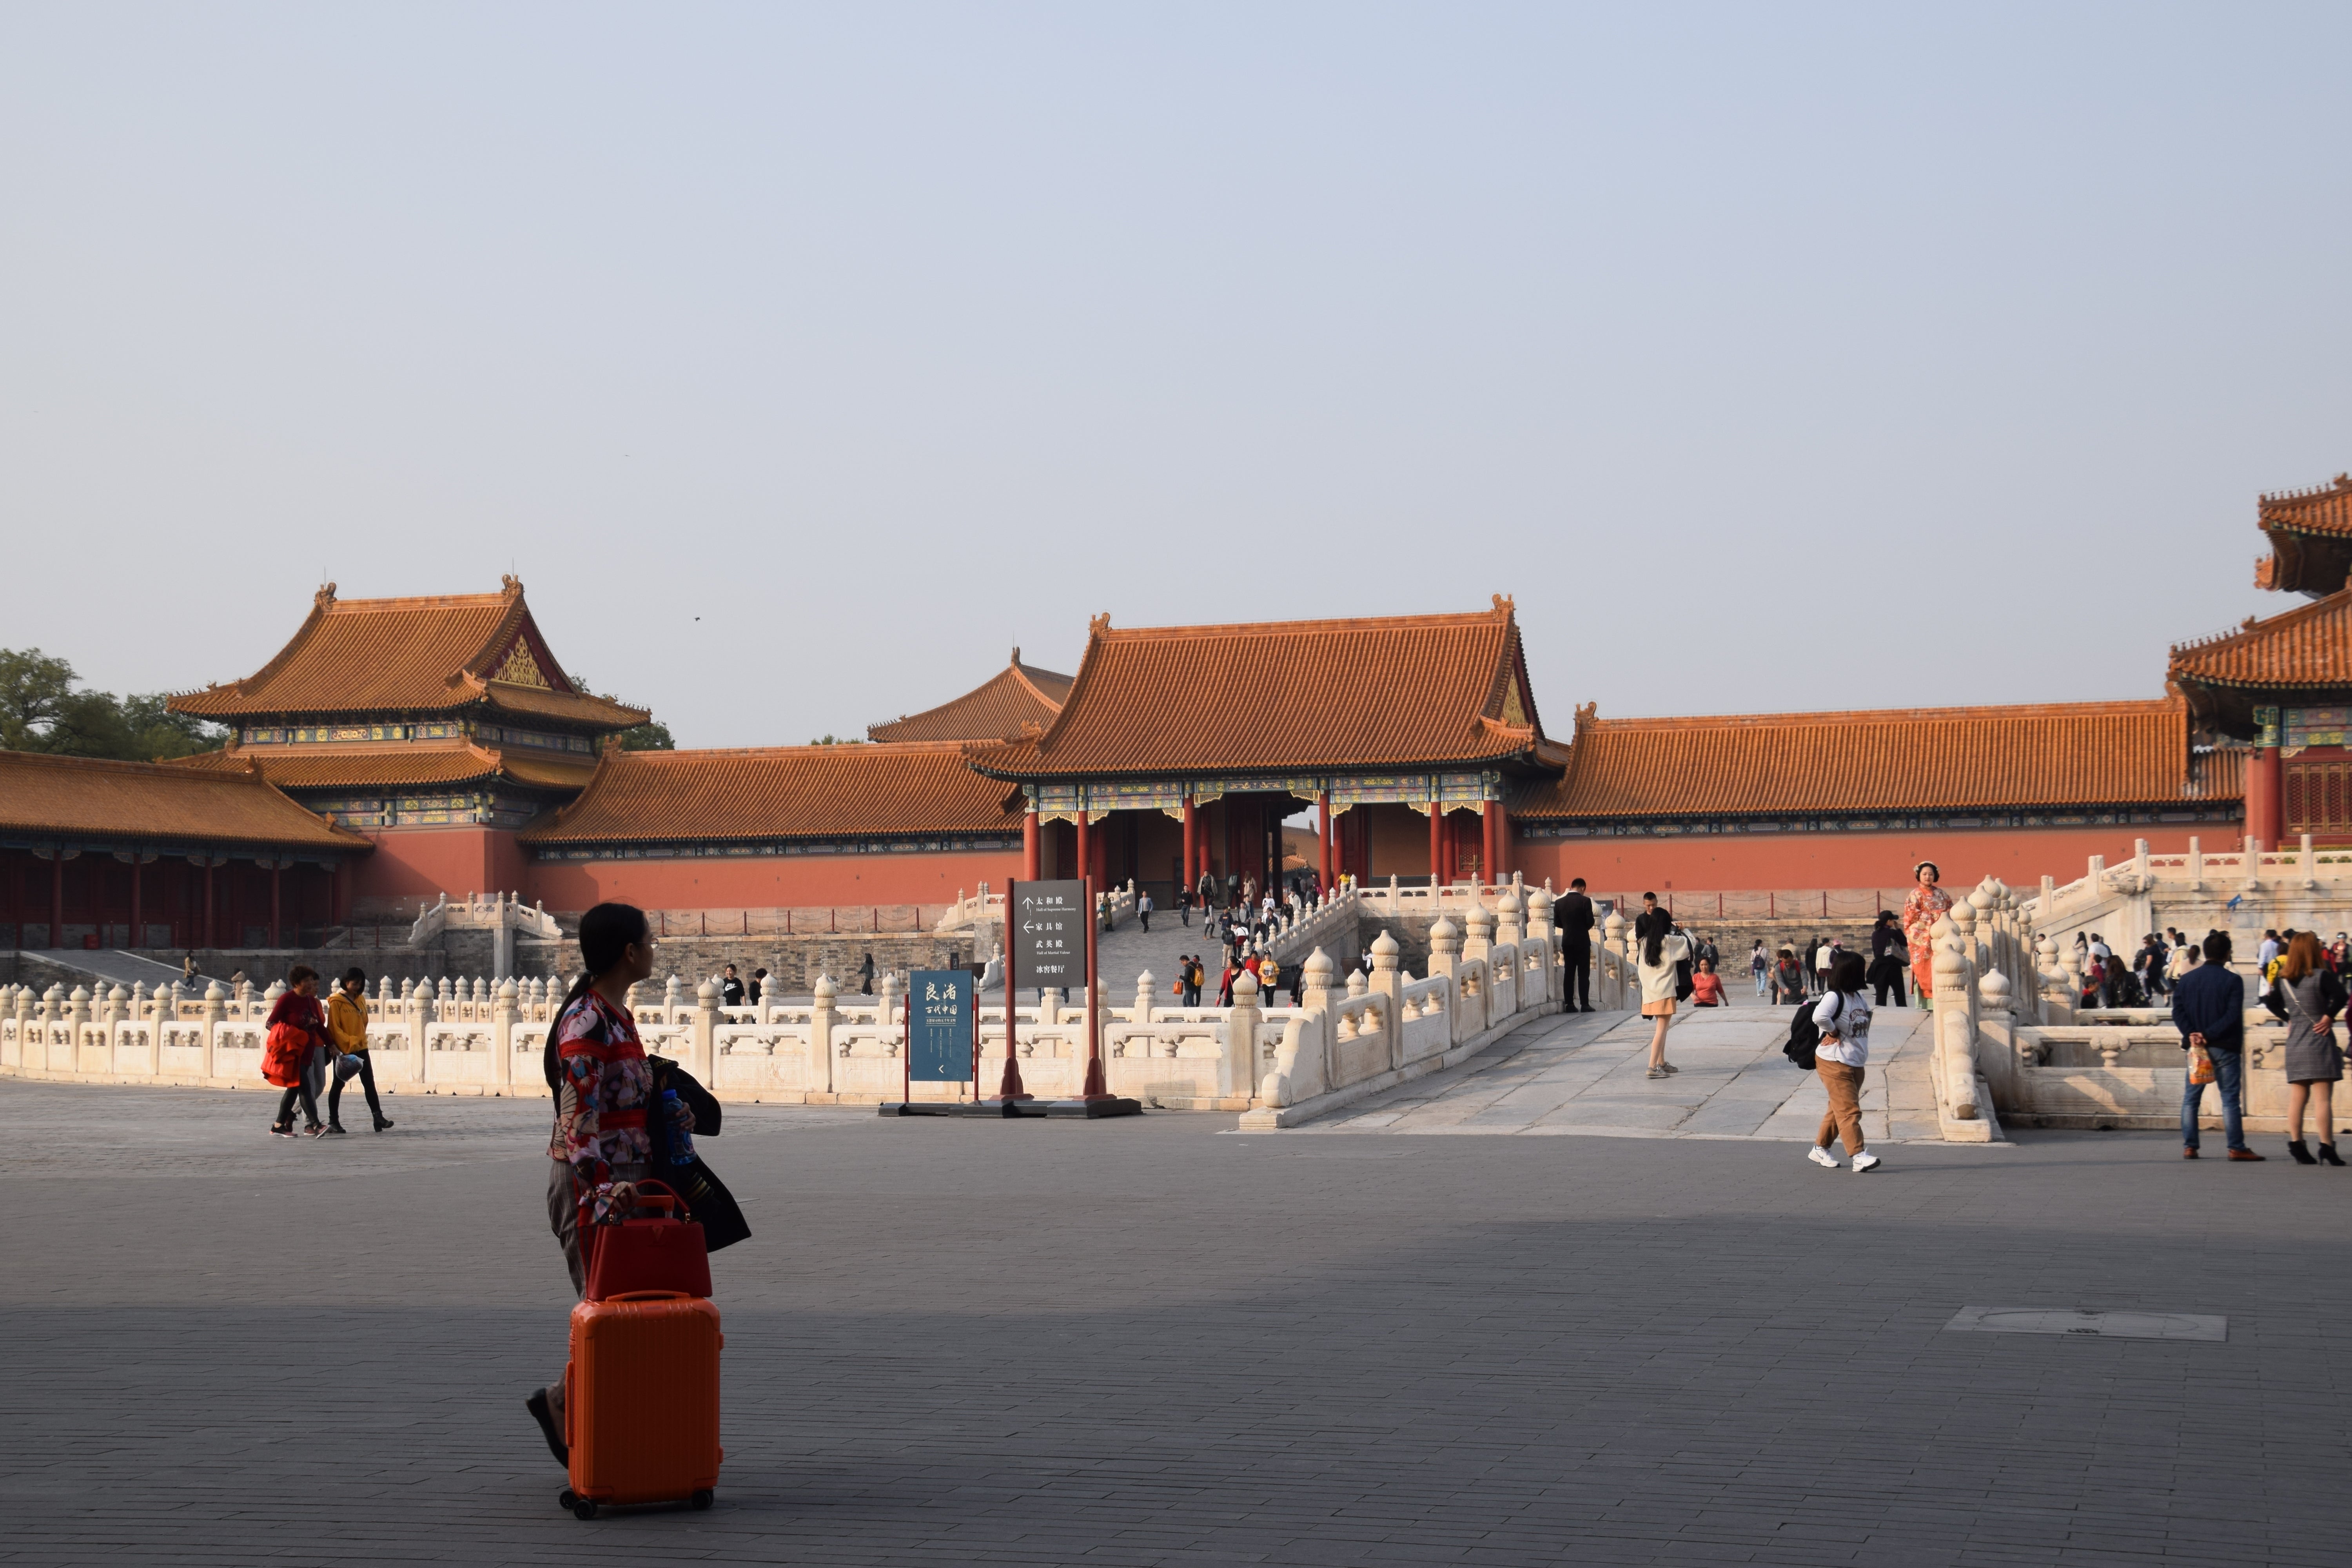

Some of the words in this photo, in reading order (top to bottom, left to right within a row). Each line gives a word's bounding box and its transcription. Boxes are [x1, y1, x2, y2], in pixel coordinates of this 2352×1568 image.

[1036, 896, 1063, 905] 太和殿
[1035, 922, 1063, 931] 家具馆
[1036, 940, 1063, 948] 武英殿
[1036, 965, 1065, 973] 冰窖餐厅
[926, 982, 956, 1001] 良渚
[925, 1004, 957, 1015] 古代中国
